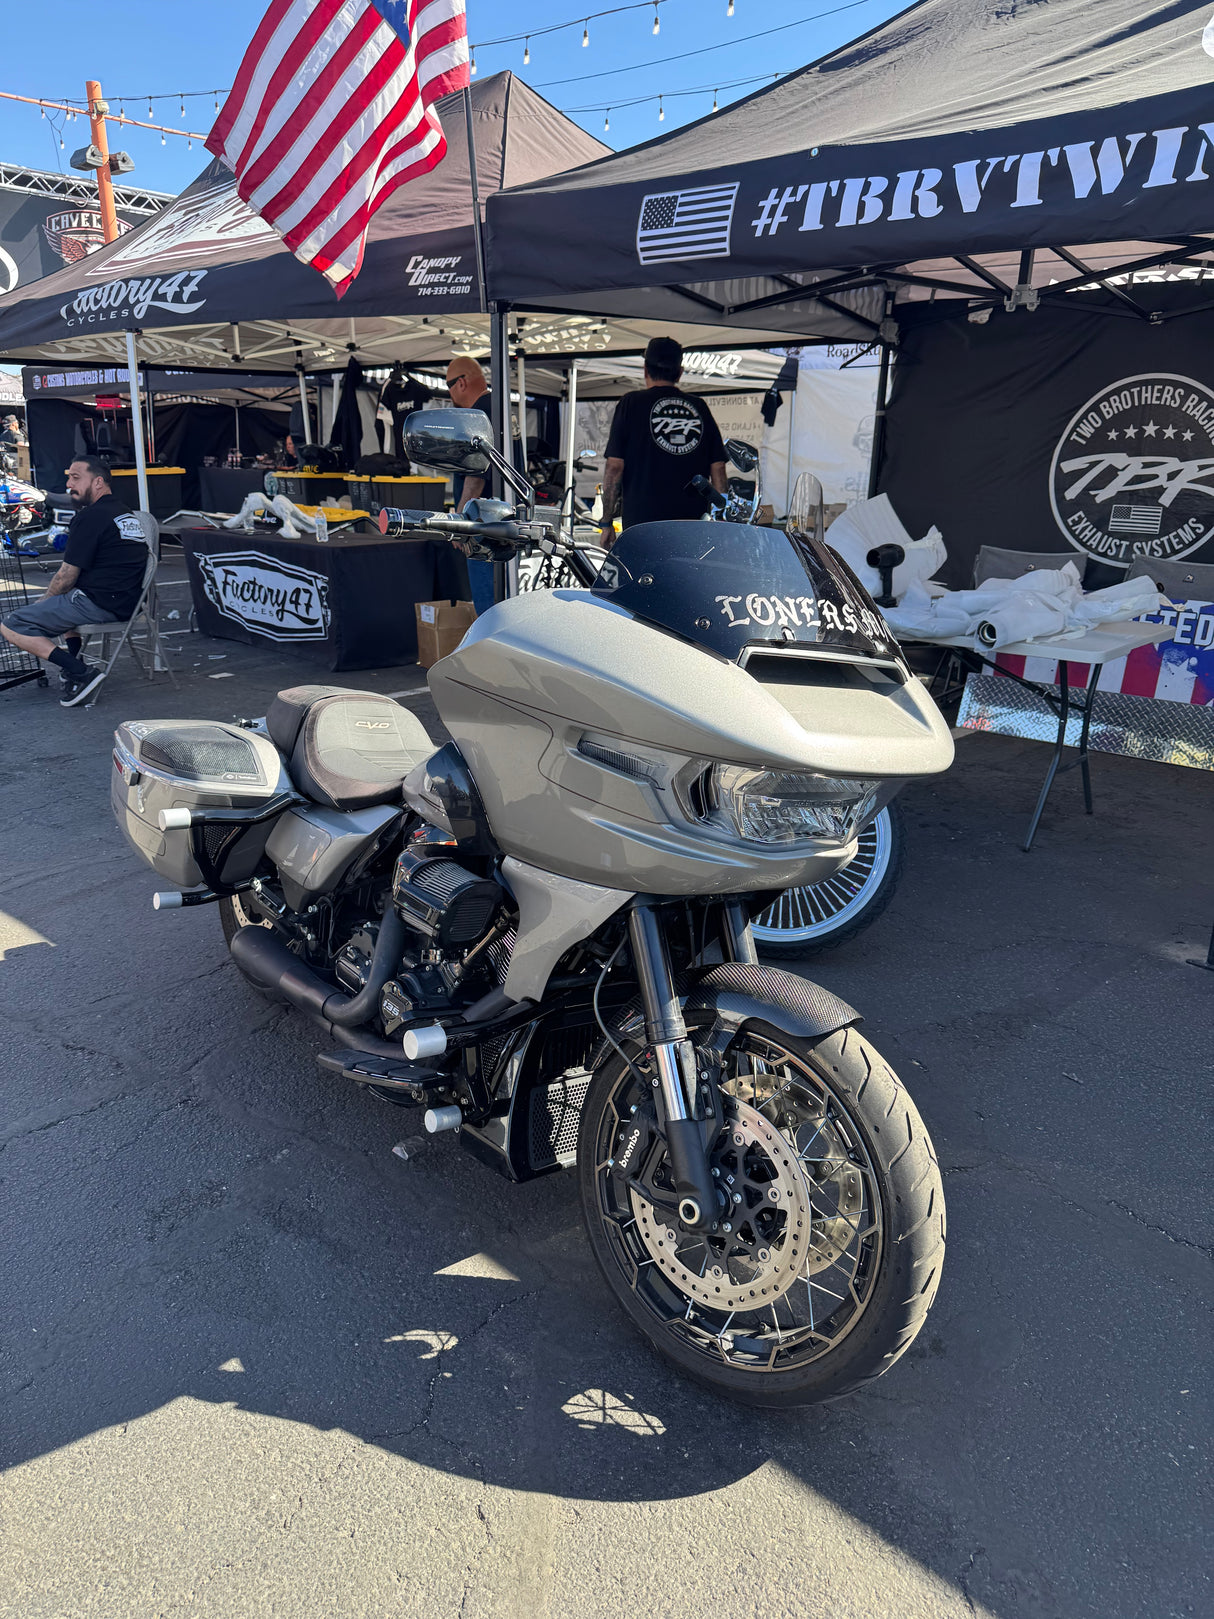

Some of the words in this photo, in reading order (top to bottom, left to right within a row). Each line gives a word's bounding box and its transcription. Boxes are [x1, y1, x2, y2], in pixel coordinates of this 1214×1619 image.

[405, 255, 462, 273] CANOPY
[67, 308, 130, 327] CYCLES
[1069, 411, 1102, 445] TWO
[1100, 385, 1184, 420] BROTHERS
[1181, 393, 1214, 446] RACIN
[652, 417, 701, 435] TBR
[1060, 453, 1214, 508] TBR
[1067, 511, 1130, 558] EXHAUST
[1131, 517, 1205, 559] SYSTEMS
[229, 601, 275, 617] CYCLES
[355, 721, 390, 730] CVO
[618, 1129, 640, 1169] brembo
